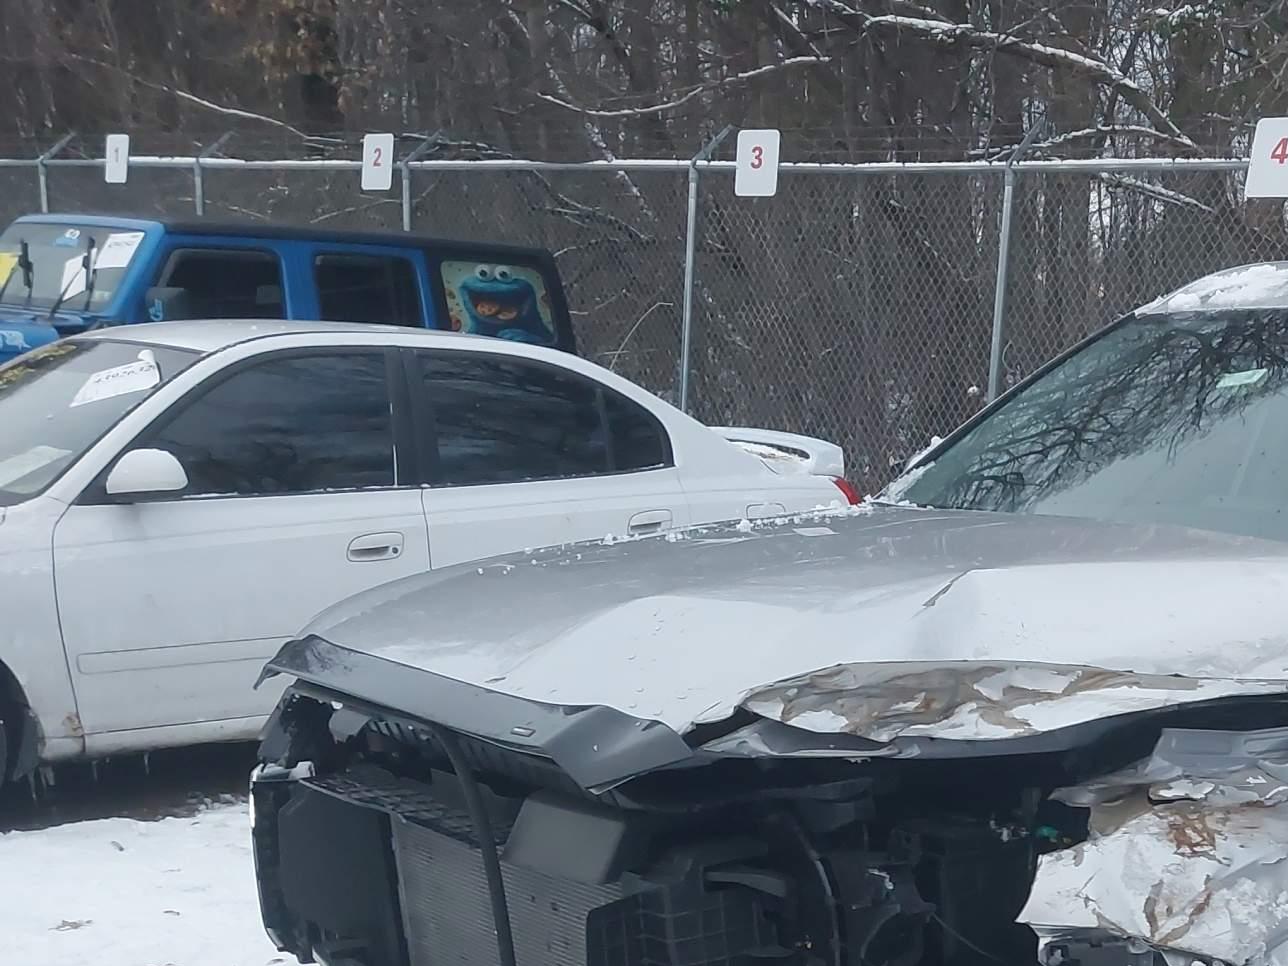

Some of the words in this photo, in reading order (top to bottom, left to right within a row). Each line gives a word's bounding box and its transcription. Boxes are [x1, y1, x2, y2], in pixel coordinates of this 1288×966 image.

[114, 146, 120, 164] 1
[373, 147, 382, 167] 2
[750, 146, 763, 170] 3
[1270, 137, 1288, 165] 4
